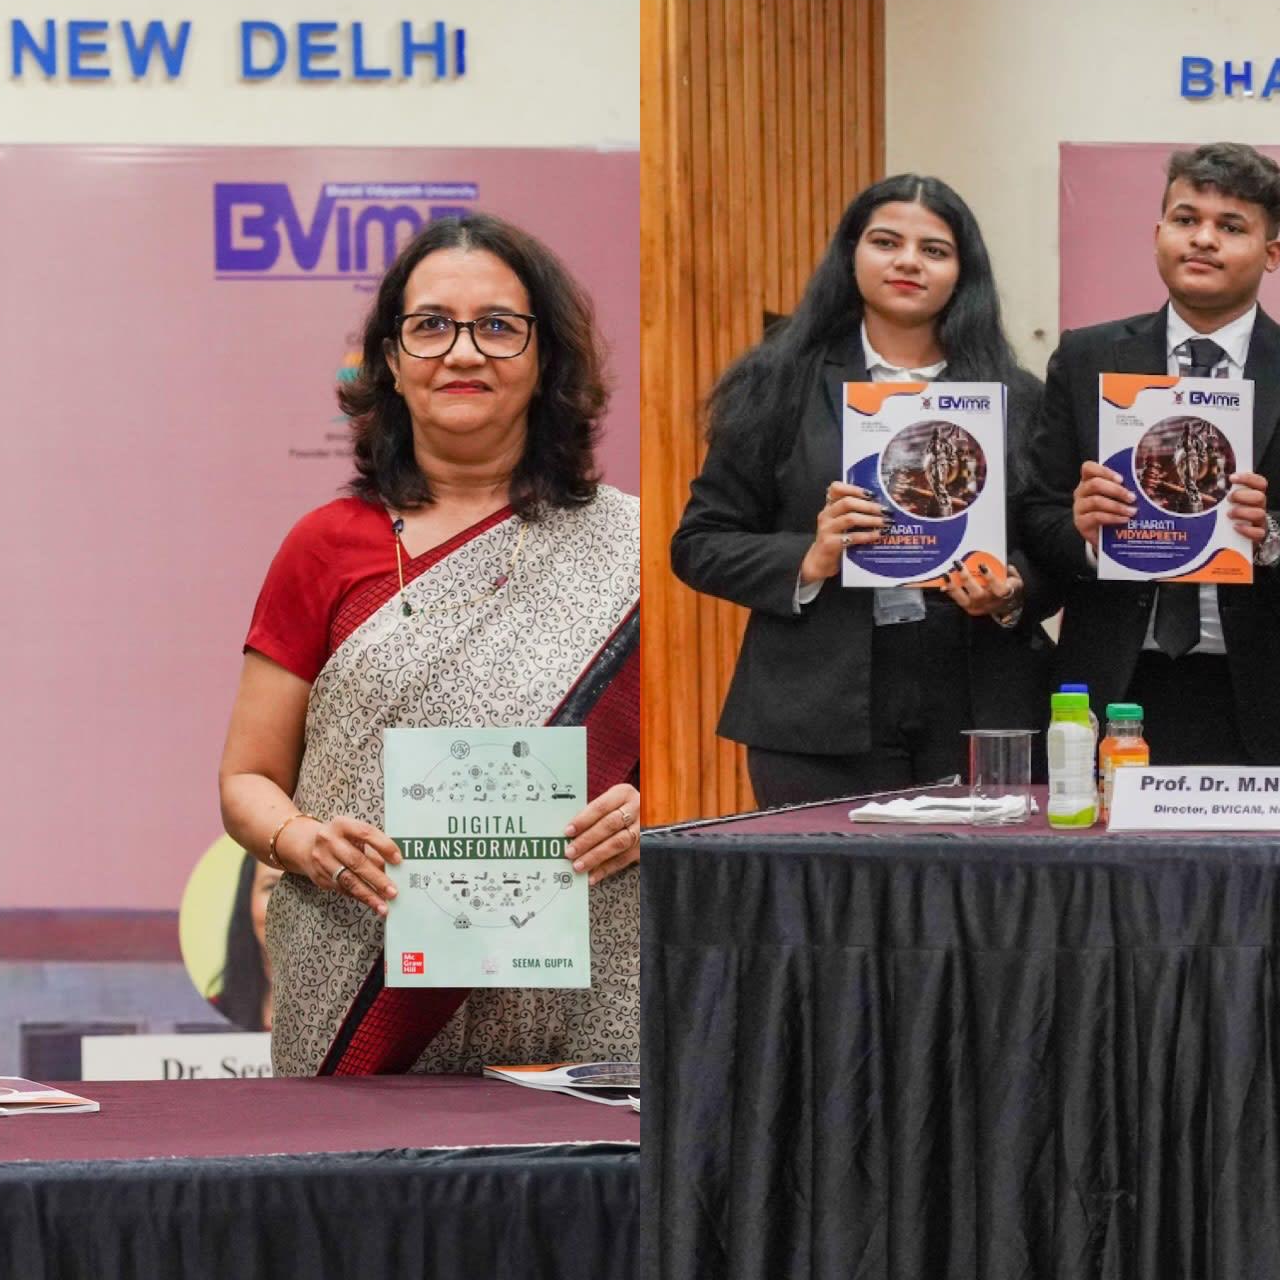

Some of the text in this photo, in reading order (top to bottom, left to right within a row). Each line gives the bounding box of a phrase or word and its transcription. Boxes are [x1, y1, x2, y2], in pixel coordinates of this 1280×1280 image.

[10, 18, 192, 80] NEW
[241, 20, 467, 80] DELHI
[1127, 519, 1175, 530] BHARATI
[1115, 530, 1187, 541] VIDYAPEETH
[1140, 775, 1191, 791] Prof.
[1199, 776, 1230, 792] Dr.
[1153, 804, 1208, 816] Director,
[447, 815, 527, 835] DIGITAL
[512, 958, 574, 969] SEEMA GUPTA
